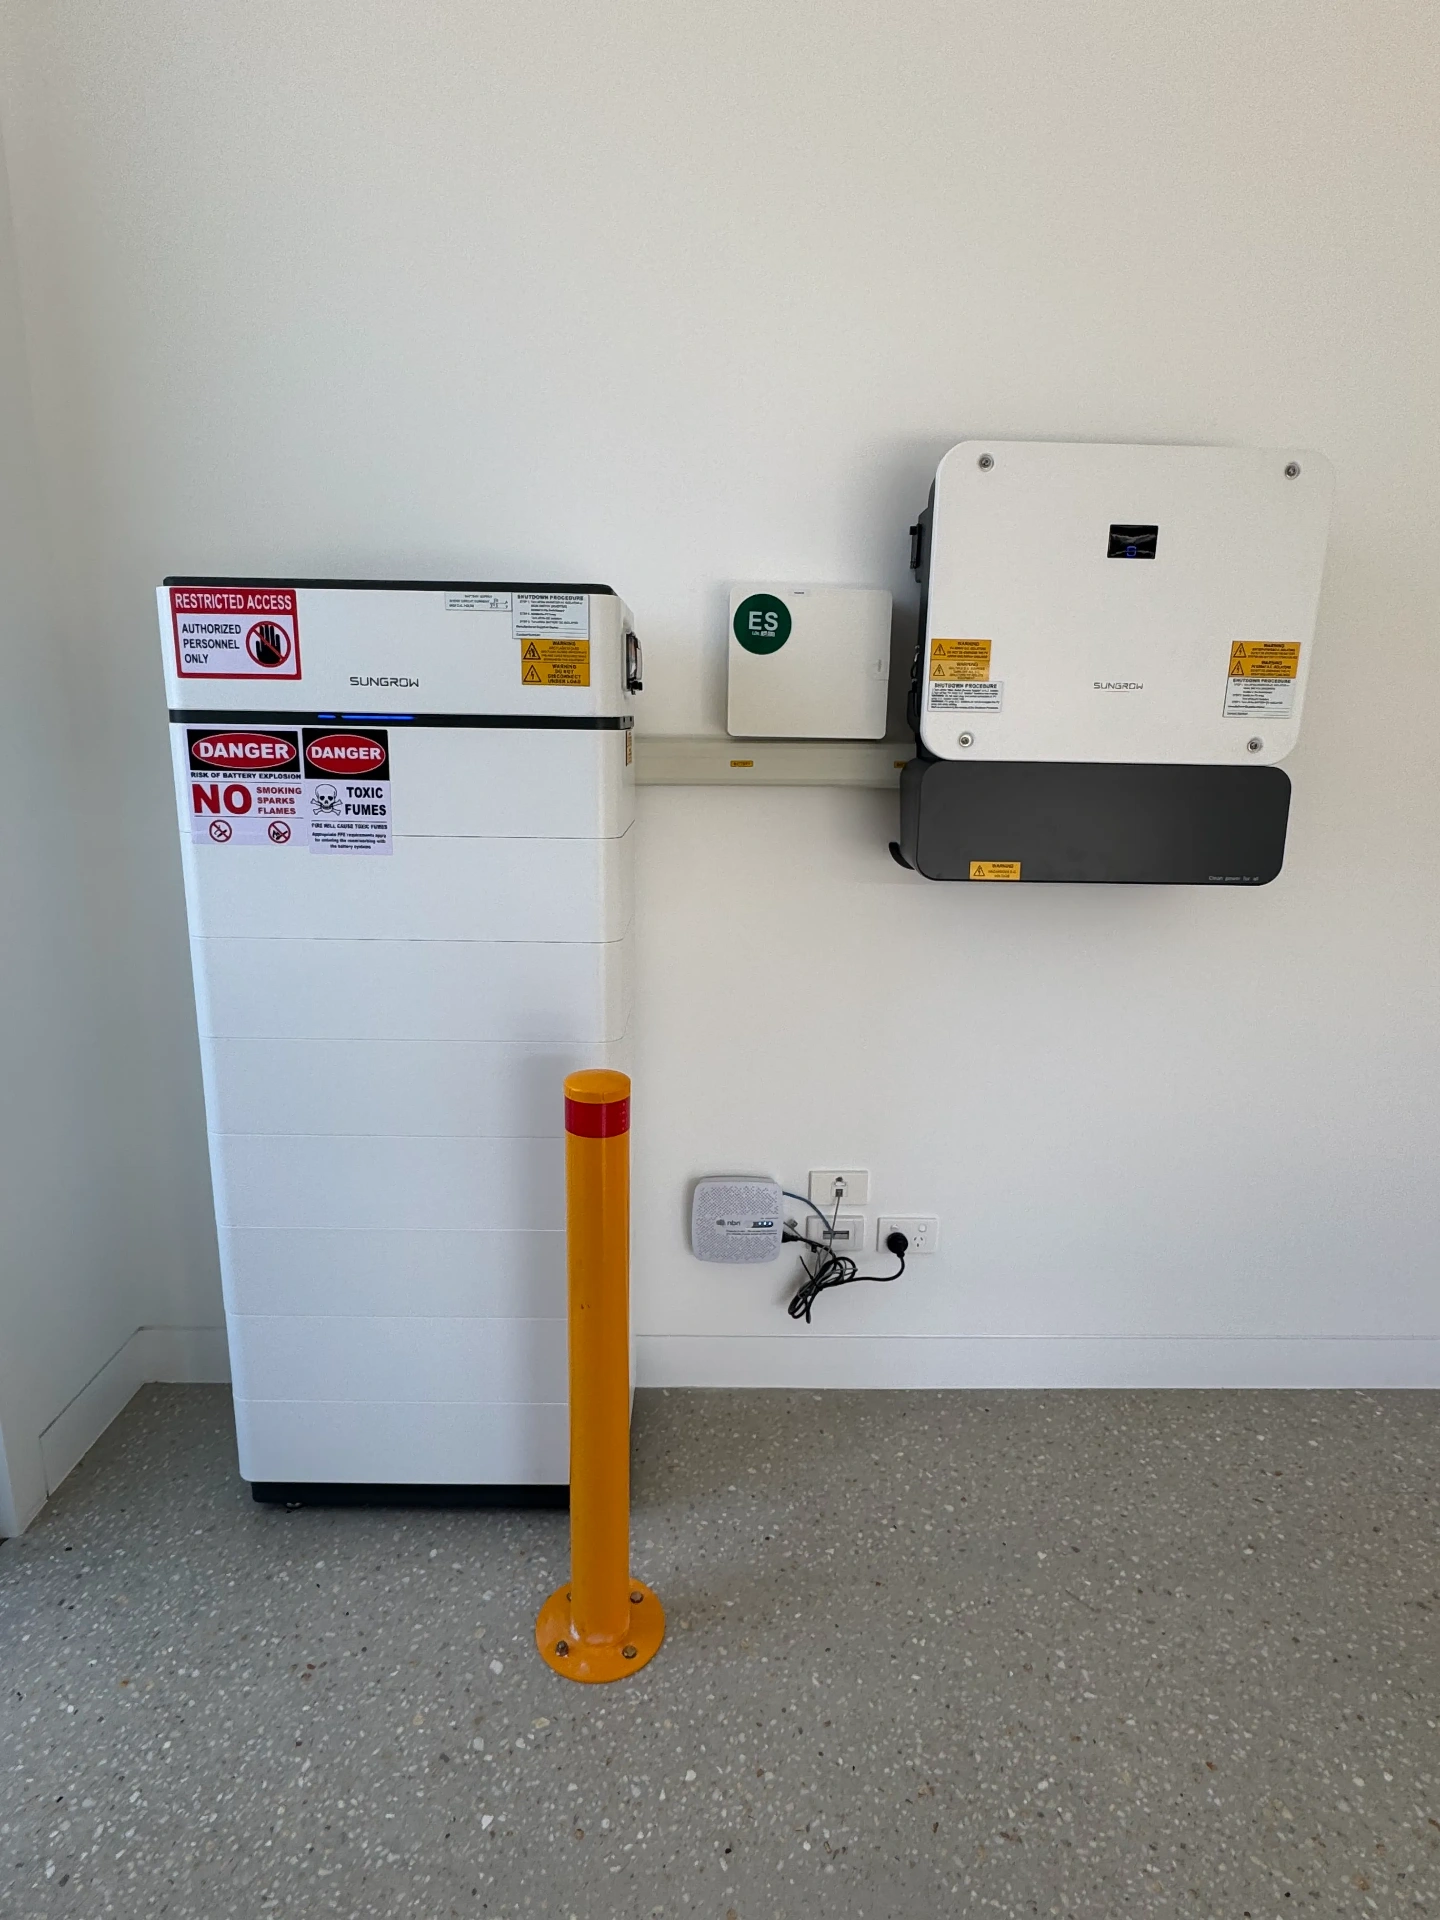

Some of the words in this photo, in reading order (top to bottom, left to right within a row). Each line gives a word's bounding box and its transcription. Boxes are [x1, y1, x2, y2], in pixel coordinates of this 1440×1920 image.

[175, 593, 244, 609] RESTRICTED
[246, 594, 292, 610] ACCESS
[748, 611, 778, 631] ES
[182, 624, 242, 634] AUTHORIZED
[183, 638, 240, 650] PERSONNEL
[184, 654, 209, 664] ONLY
[350, 676, 419, 687] SUNGROW
[200, 742, 290, 759] DANGER
[311, 746, 382, 760] DANGER
[346, 786, 383, 798] TOXIC
[192, 784, 252, 814] NO
[345, 804, 386, 816] FUMES
